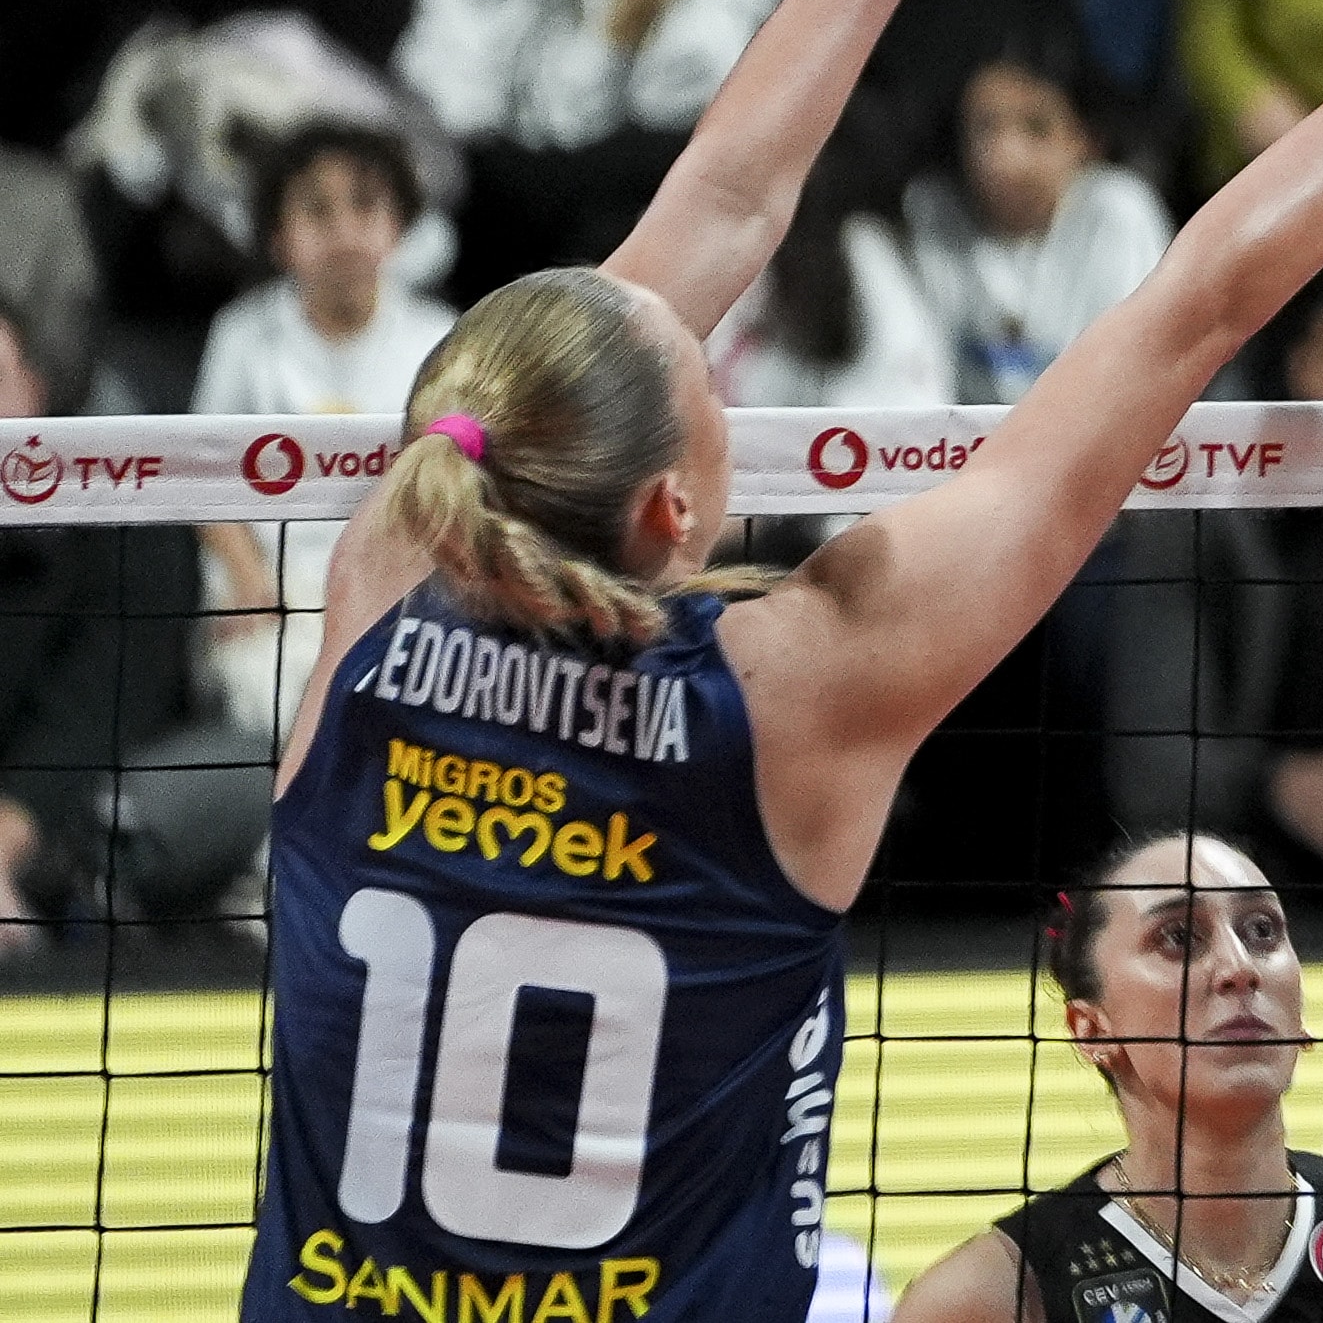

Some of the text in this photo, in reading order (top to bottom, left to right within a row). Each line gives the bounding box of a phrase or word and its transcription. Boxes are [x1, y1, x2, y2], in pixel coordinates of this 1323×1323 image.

[74, 456, 163, 491] TVF
[315, 443, 400, 477] vod
[878, 436, 985, 471] voda
[1199, 442, 1285, 478] TVF
[353, 617, 690, 763] EDOROVTSEVA
[367, 779, 658, 882] yemek
[337, 887, 669, 1250] 10
[286, 1227, 661, 1323] SANMAR
